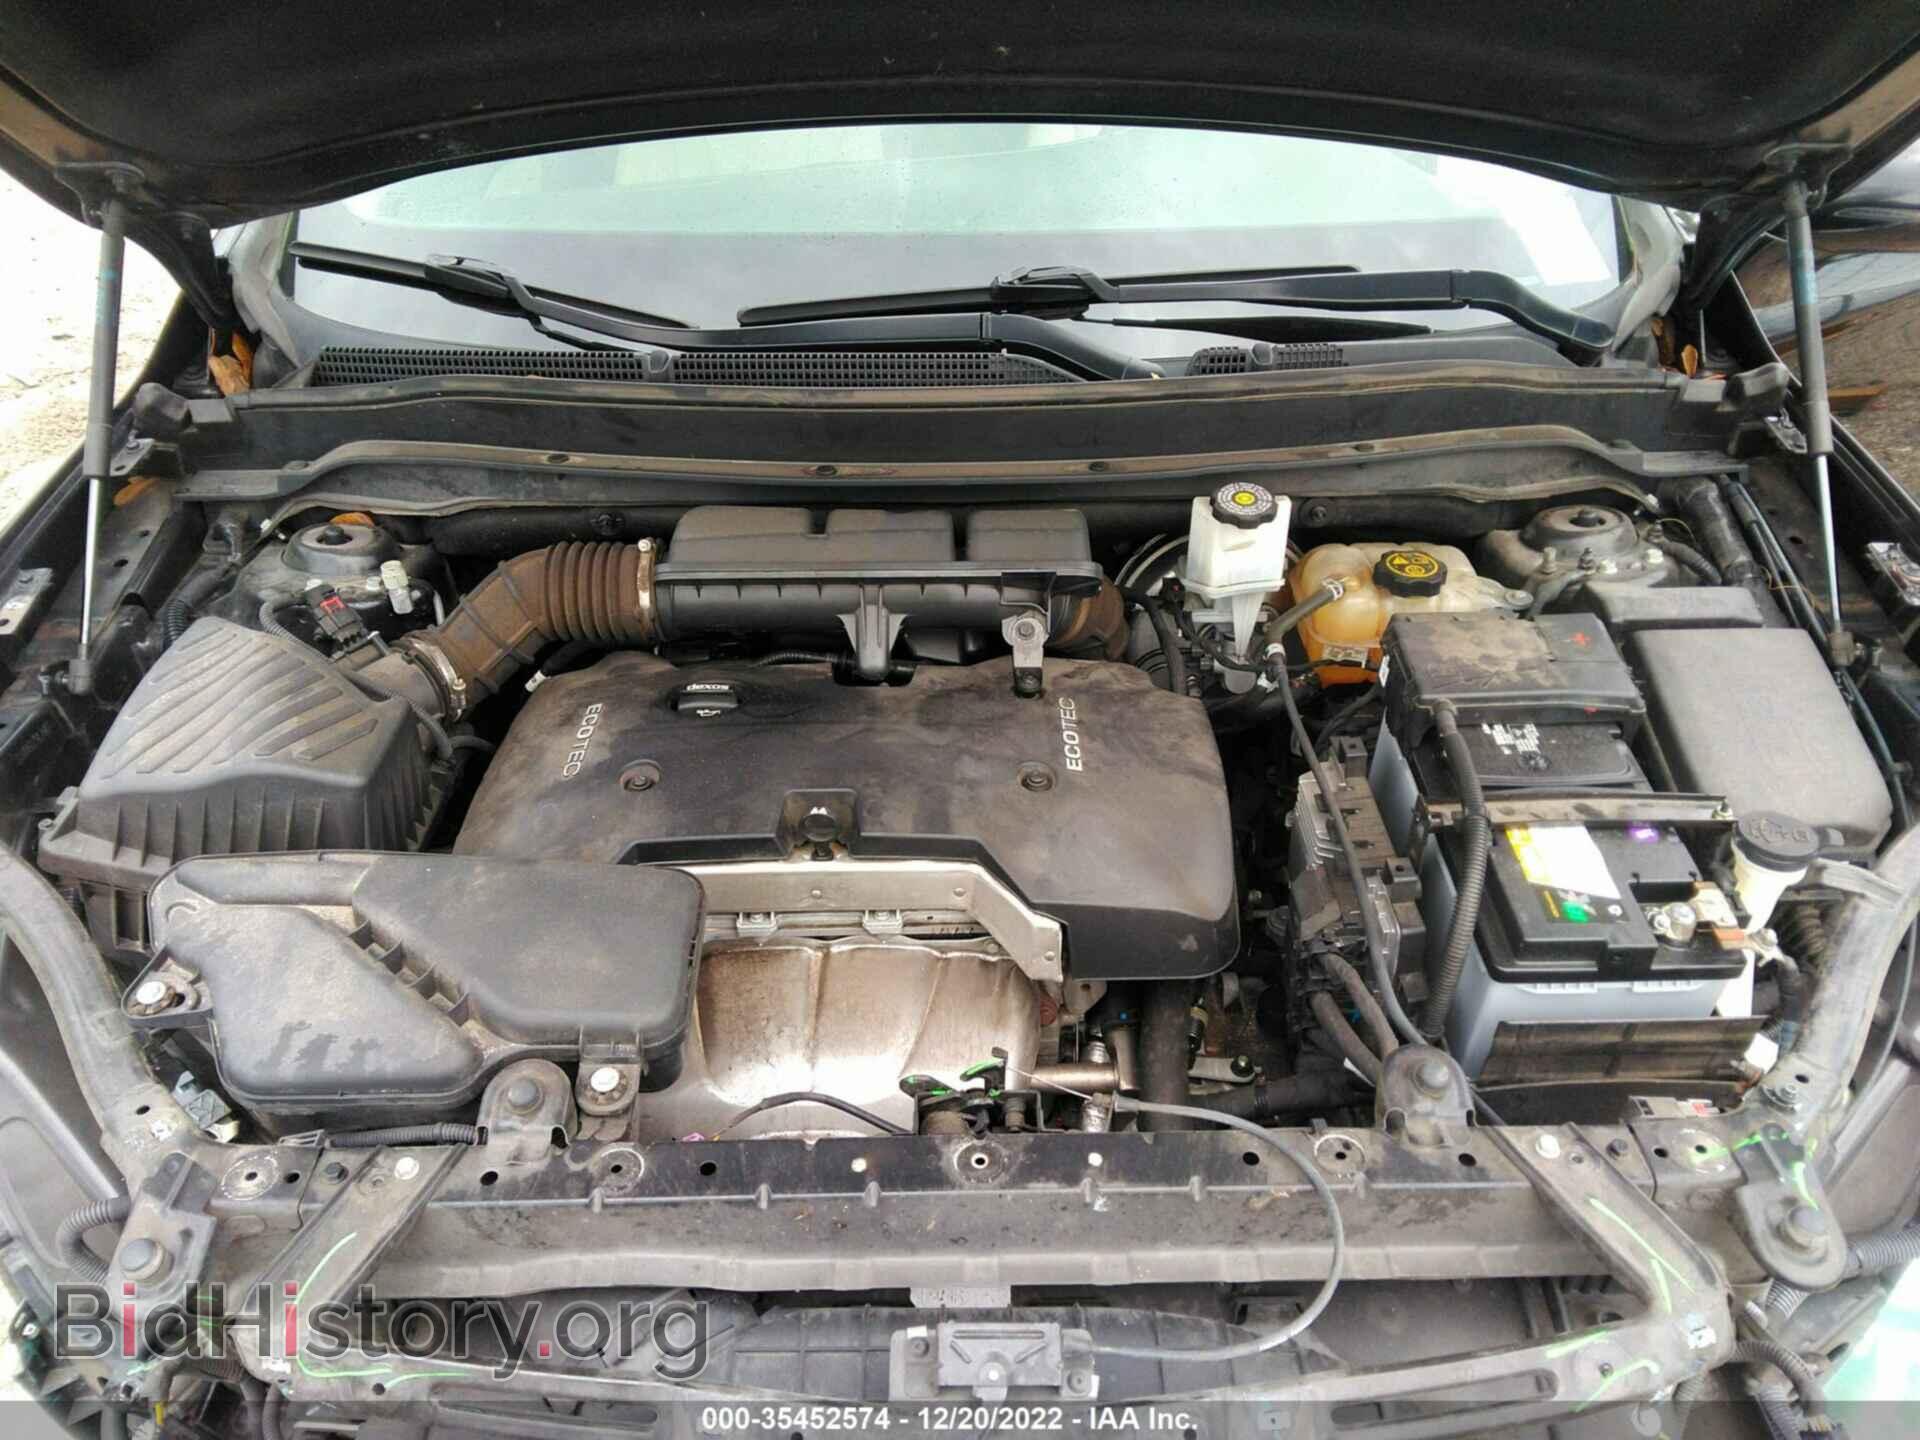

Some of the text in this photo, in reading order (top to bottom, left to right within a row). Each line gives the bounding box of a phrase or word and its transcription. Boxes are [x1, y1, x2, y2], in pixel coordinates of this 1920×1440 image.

[686, 683, 730, 692] dexos
[562, 703, 603, 777] ECOTEC
[1058, 697, 1084, 772] ECOTEC
